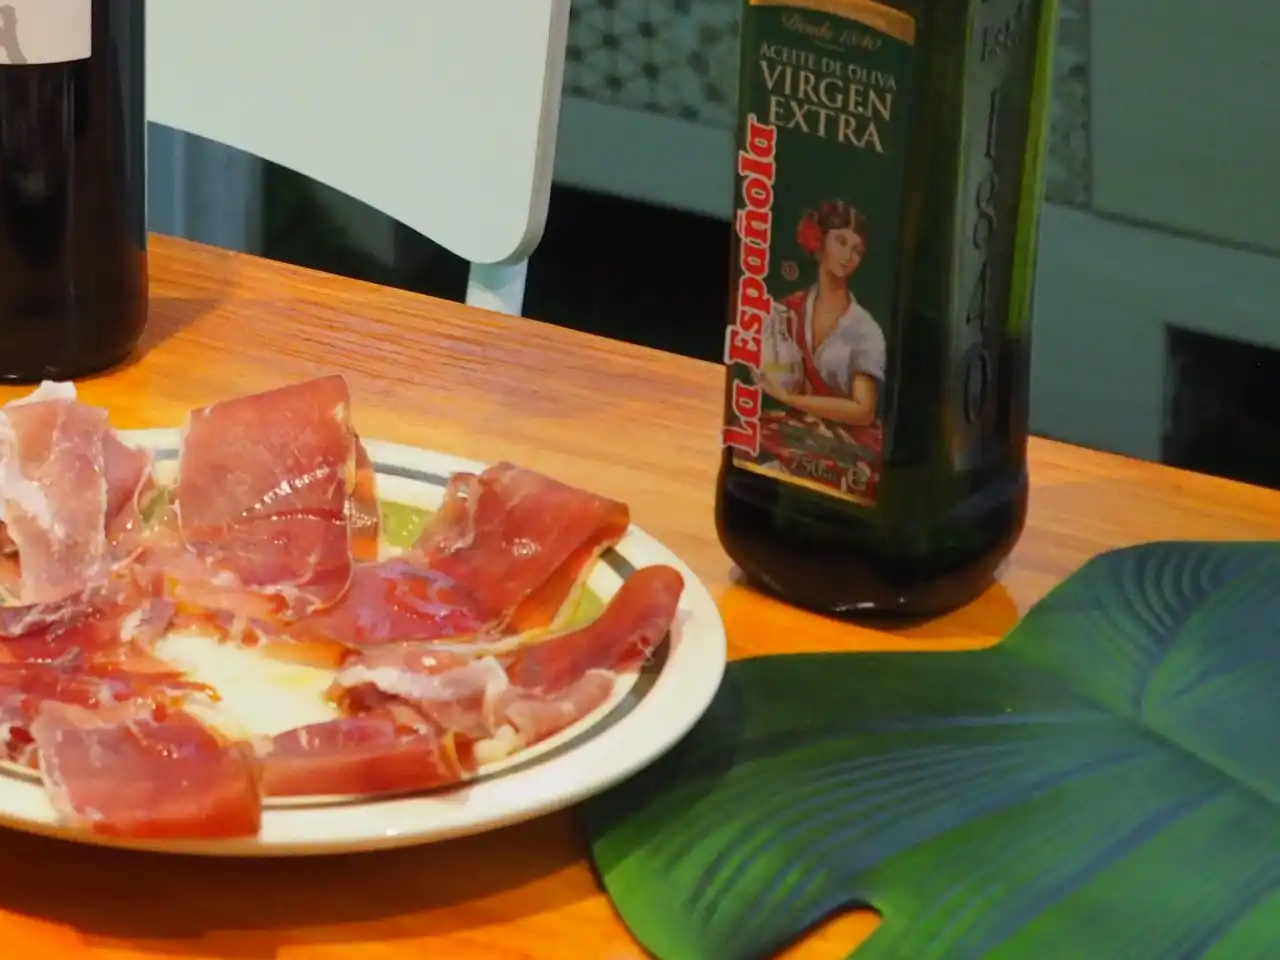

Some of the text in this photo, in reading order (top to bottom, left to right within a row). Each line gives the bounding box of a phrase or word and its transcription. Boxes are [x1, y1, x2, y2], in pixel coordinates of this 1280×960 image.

[759, 41, 818, 71] ACEITE
[847, 62, 898, 91] OLIVA
[759, 60, 894, 122] VIRGEN
[768, 95, 885, 154] EXTRA
[721, 113, 777, 456] La Española
